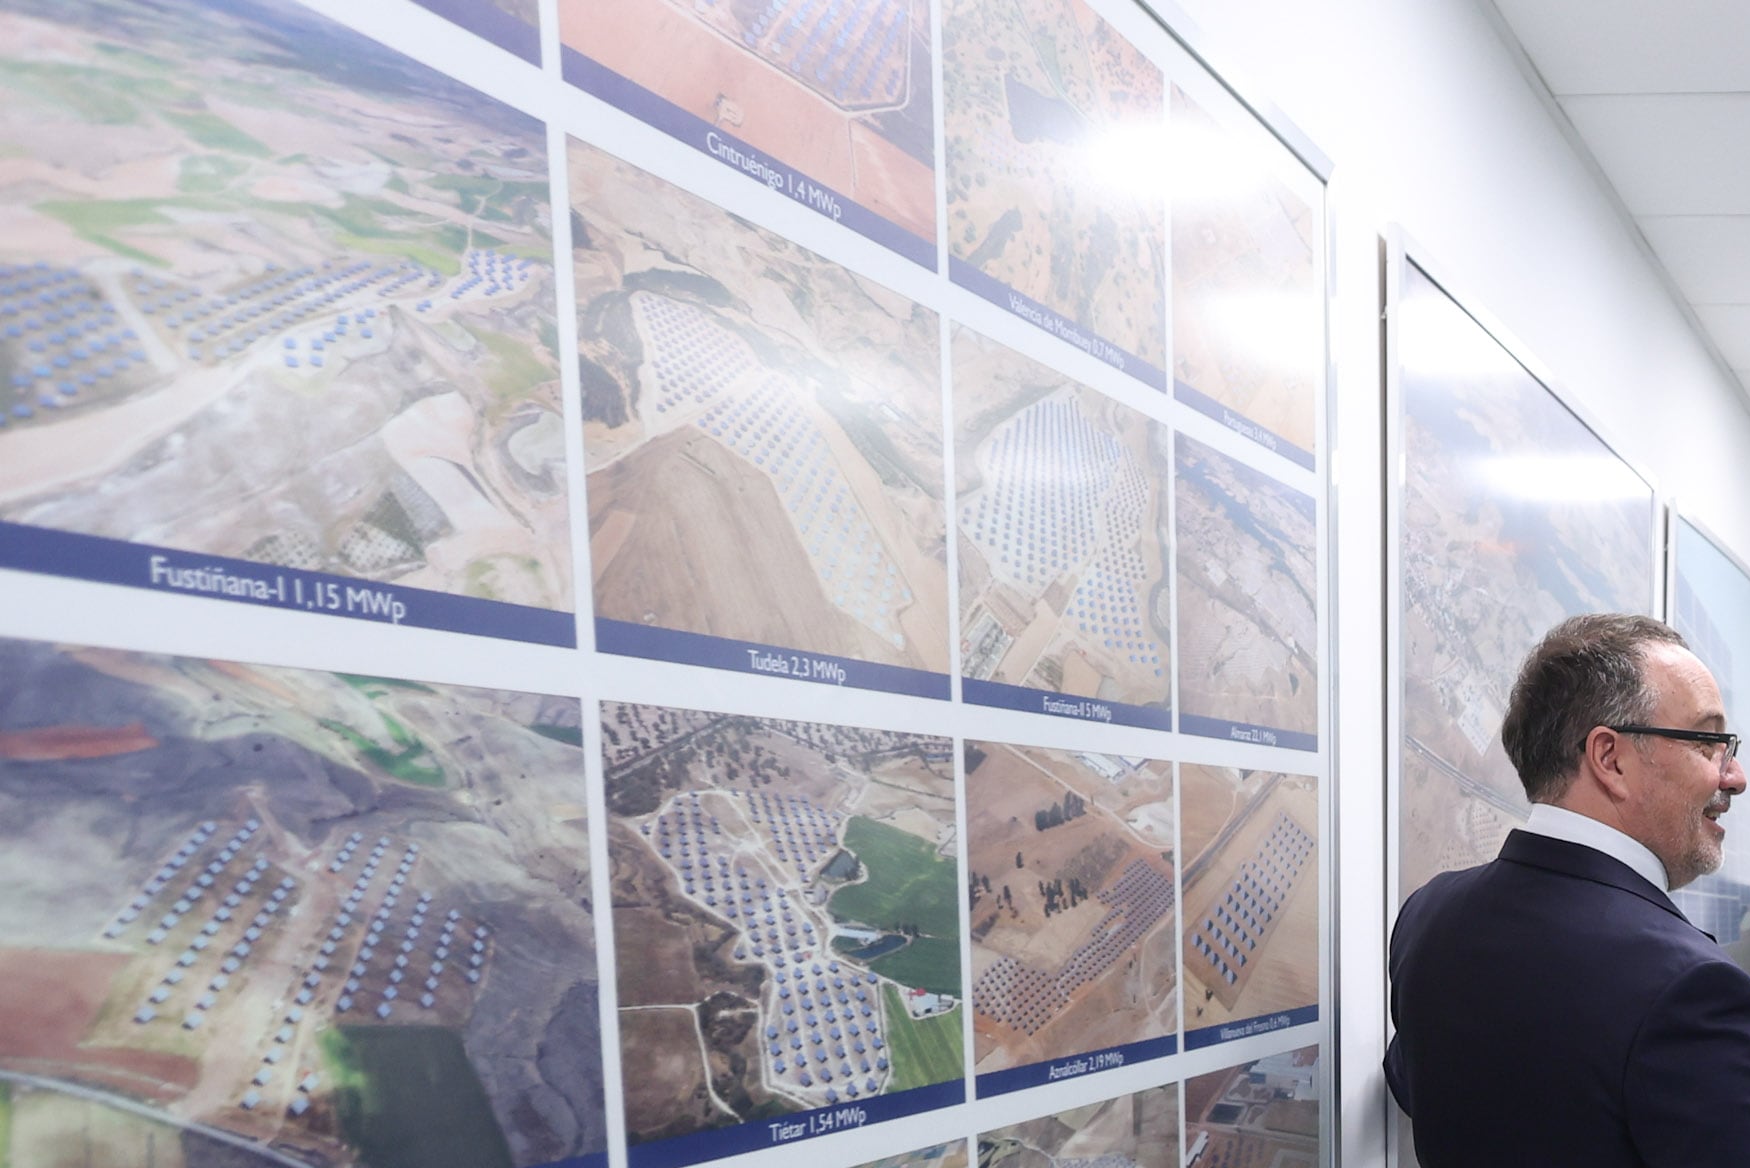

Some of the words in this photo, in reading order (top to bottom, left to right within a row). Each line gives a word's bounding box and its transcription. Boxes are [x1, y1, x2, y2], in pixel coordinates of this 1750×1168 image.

[706, 131, 784, 191] Cintruénigo
[788, 174, 806, 199] 1,4
[808, 184, 842, 222] MWp
[1008, 292, 1042, 325] Valencia
[1043, 314, 1054, 331] de
[1105, 344, 1126, 370] MWp
[294, 578, 340, 610] 1,15
[346, 587, 406, 625] MWp
[747, 649, 790, 675] Tudela
[791, 656, 810, 678] 2,3
[813, 660, 847, 685] MWp
[1086, 702, 1092, 718] 5
[1092, 703, 1112, 723] MWp
[1088, 1054, 1105, 1072] 2,19
[1105, 1051, 1124, 1067] MWp
[768, 1121, 806, 1142] Tiétar
[810, 1112, 834, 1135] 1,54
[836, 1106, 867, 1127] MWp
